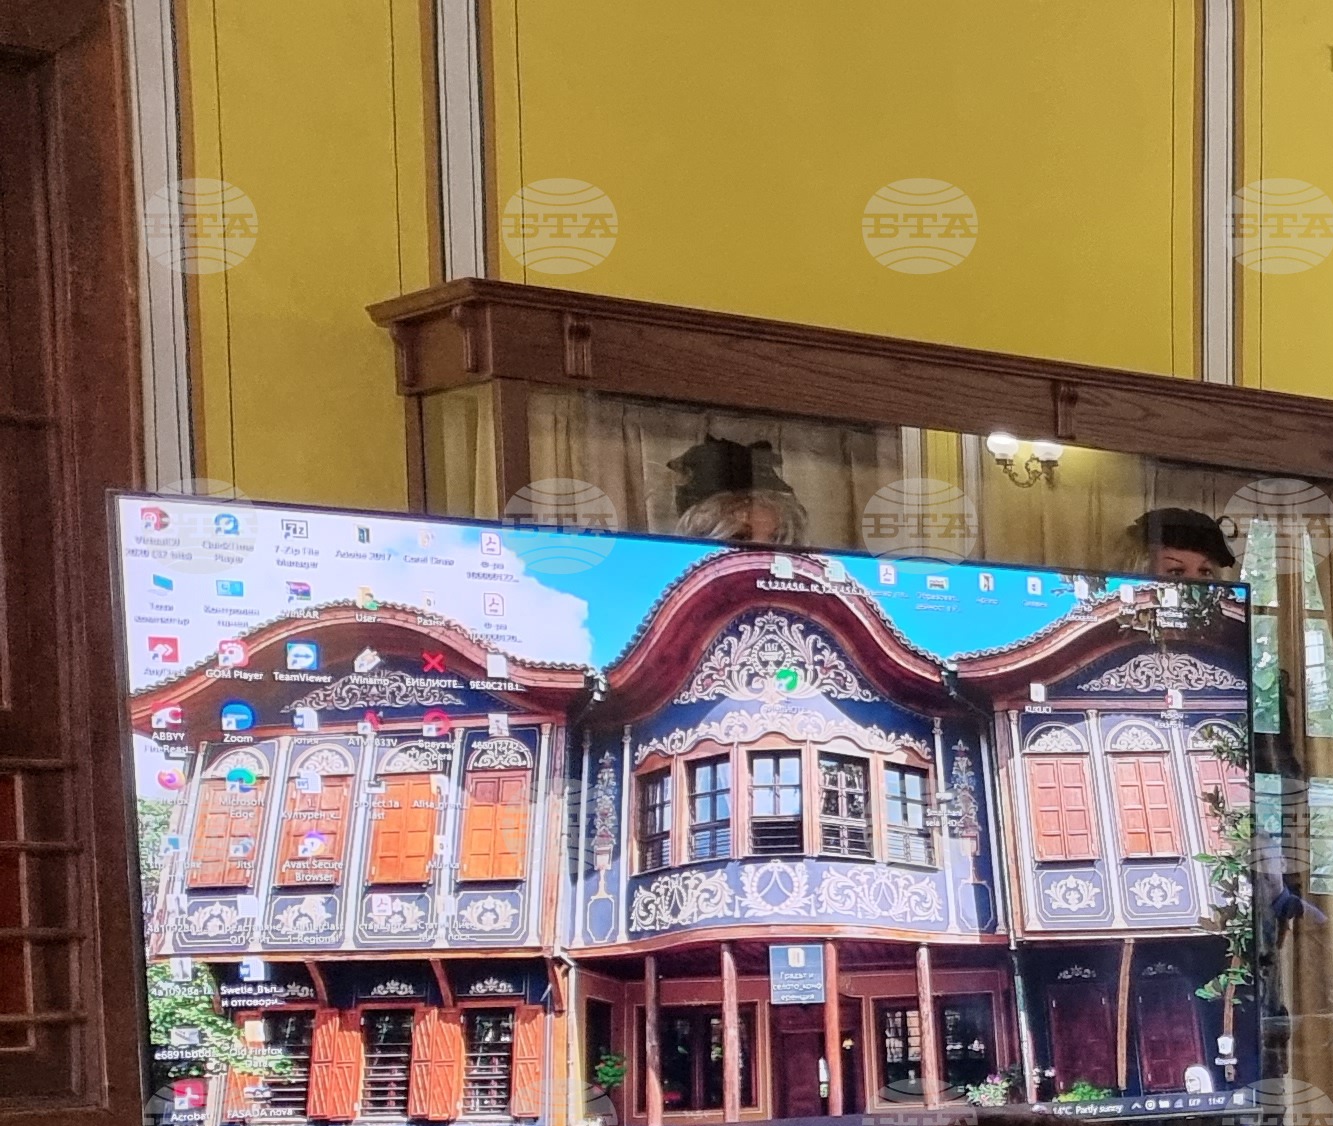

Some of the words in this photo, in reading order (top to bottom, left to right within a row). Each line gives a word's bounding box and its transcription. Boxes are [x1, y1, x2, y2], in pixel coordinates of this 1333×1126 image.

[233, 669, 264, 681] Player
[273, 672, 332, 683] TeamViewer
[350, 674, 390, 686] Winamp
[152, 732, 185, 741] ABBYY
[223, 733, 253, 744] Zoom
[220, 796, 265, 807] Microsoft
[229, 810, 255, 820] Edge
[284, 860, 311, 870] Avast
[311, 859, 344, 870] Secure
[295, 872, 334, 882] Browser
[269, 1108, 293, 1118] nova
[1075, 1103, 1098, 1117] Partly
[170, 1111, 210, 1122] Acrobat
